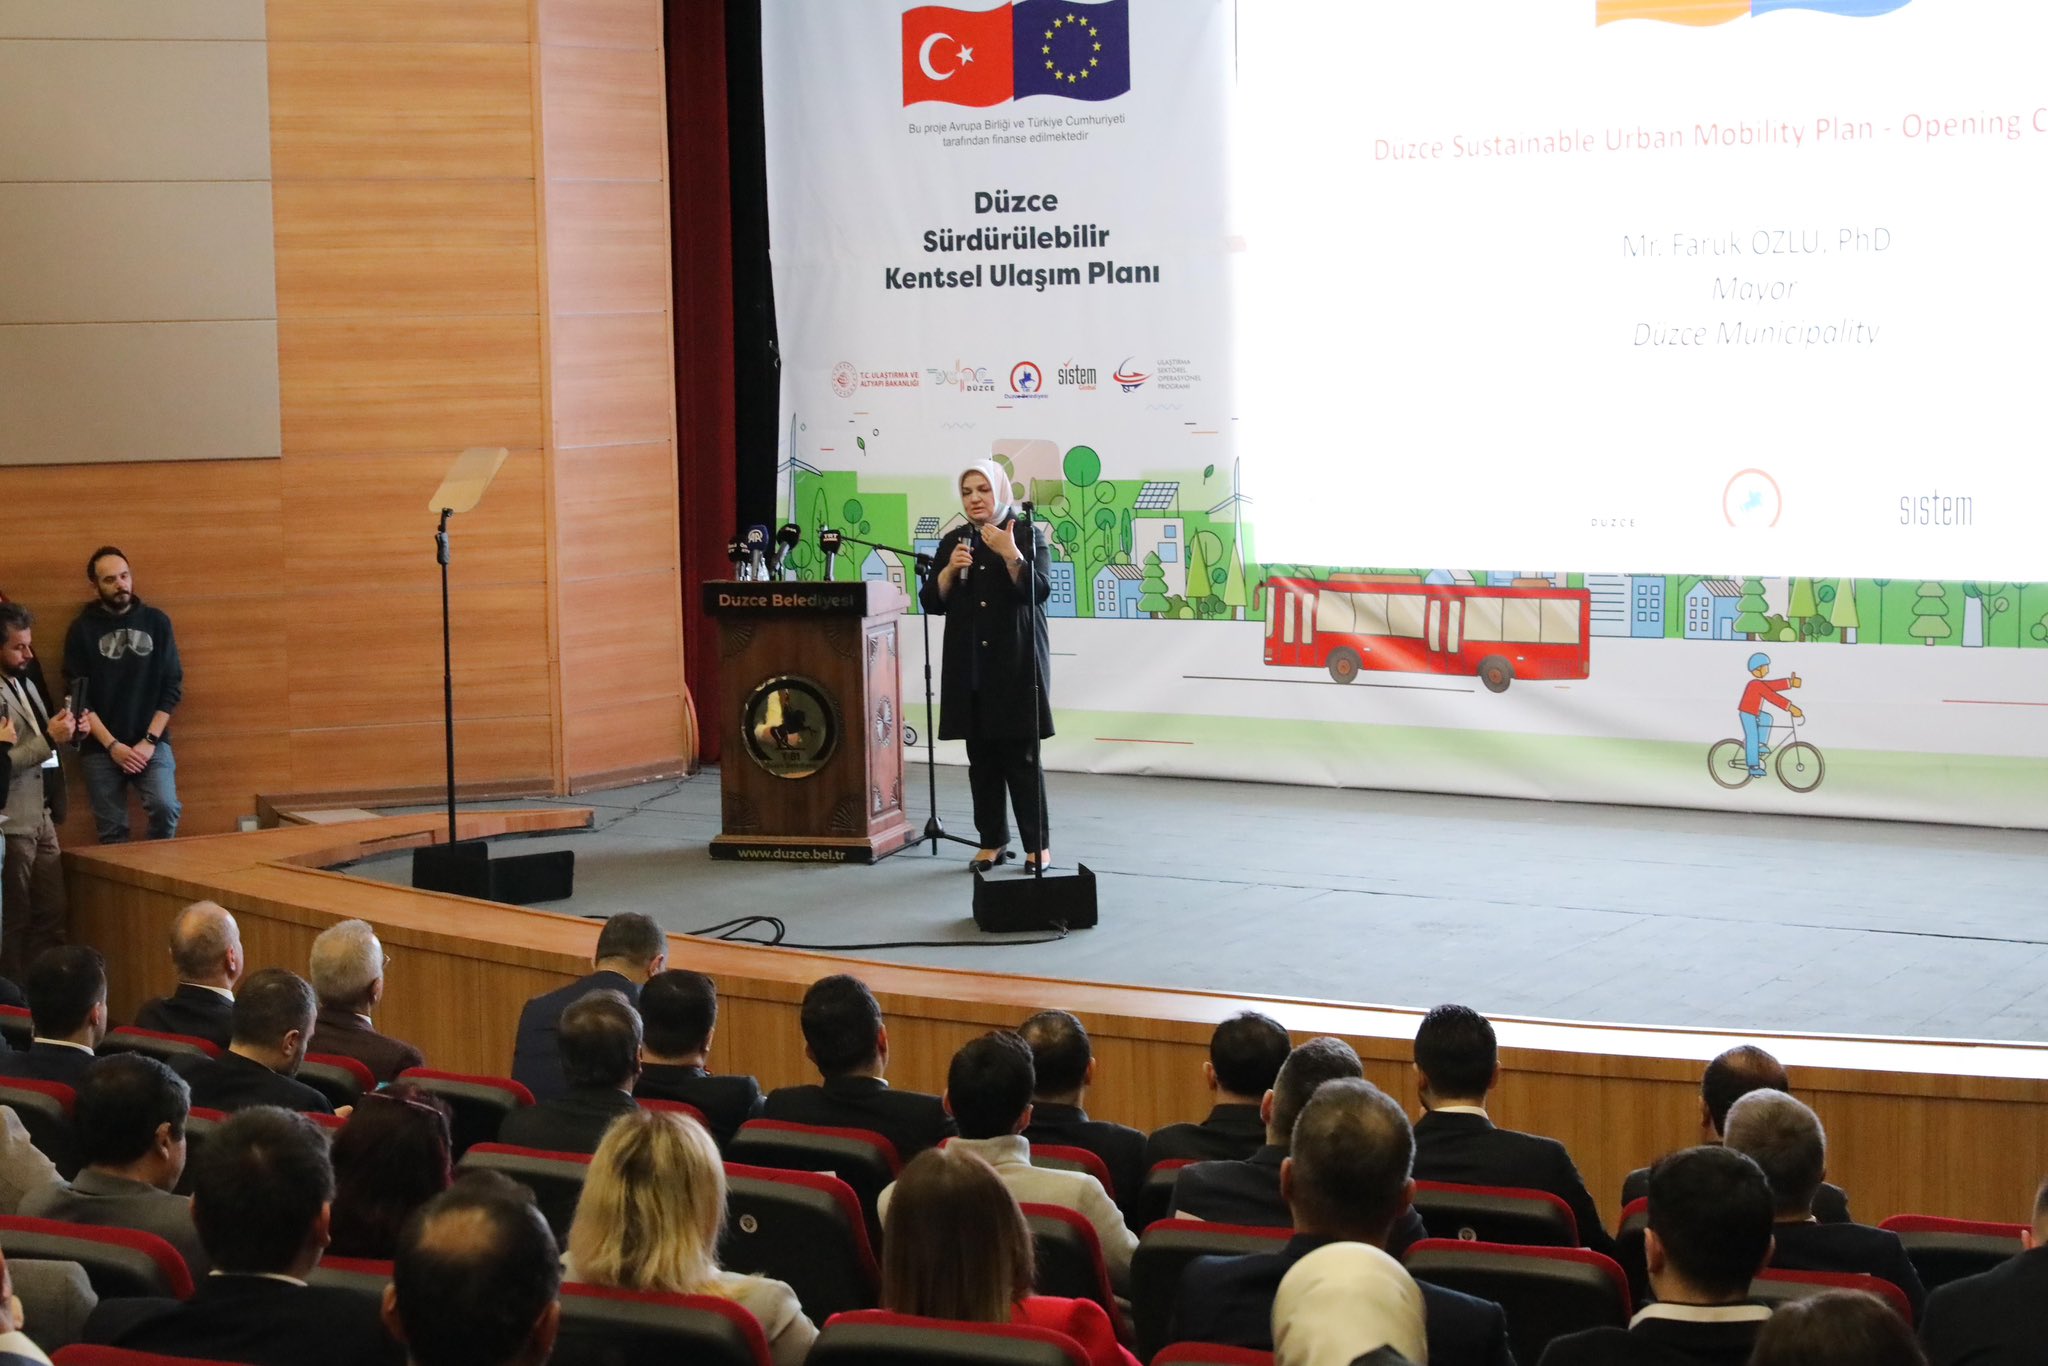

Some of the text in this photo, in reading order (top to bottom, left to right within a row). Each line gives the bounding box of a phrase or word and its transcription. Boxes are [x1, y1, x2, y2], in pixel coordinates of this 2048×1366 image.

[908, 112, 1127, 136] Bu proje Avrupa Birliği ve Türkiye Cumhuriyeti
[1452, 127, 1595, 158] Sustainable
[1605, 125, 1683, 151] Urban
[1694, 118, 1805, 149] Mobility
[1816, 115, 1873, 142] Plan
[1902, 109, 2021, 144] Opening
[942, 130, 1090, 148] tarafından finanse edilmektedir
[974, 188, 1059, 215] Düzce
[923, 223, 1110, 253] Sürdürülebilir
[1673, 230, 1742, 257] Faruk
[1838, 225, 1891, 252] PhD
[885, 259, 1160, 293] Kentsel Ulaşım Planı
[1712, 276, 1799, 304] Mayor
[1716, 317, 1881, 350] Municipality
[859, 380, 884, 388] ALTYAPI
[910, 371, 920, 379] VE
[1057, 364, 1097, 385] sistem
[771, 592, 855, 609] Belediyesi
[737, 848, 847, 861] www.duzce.bel.tr
